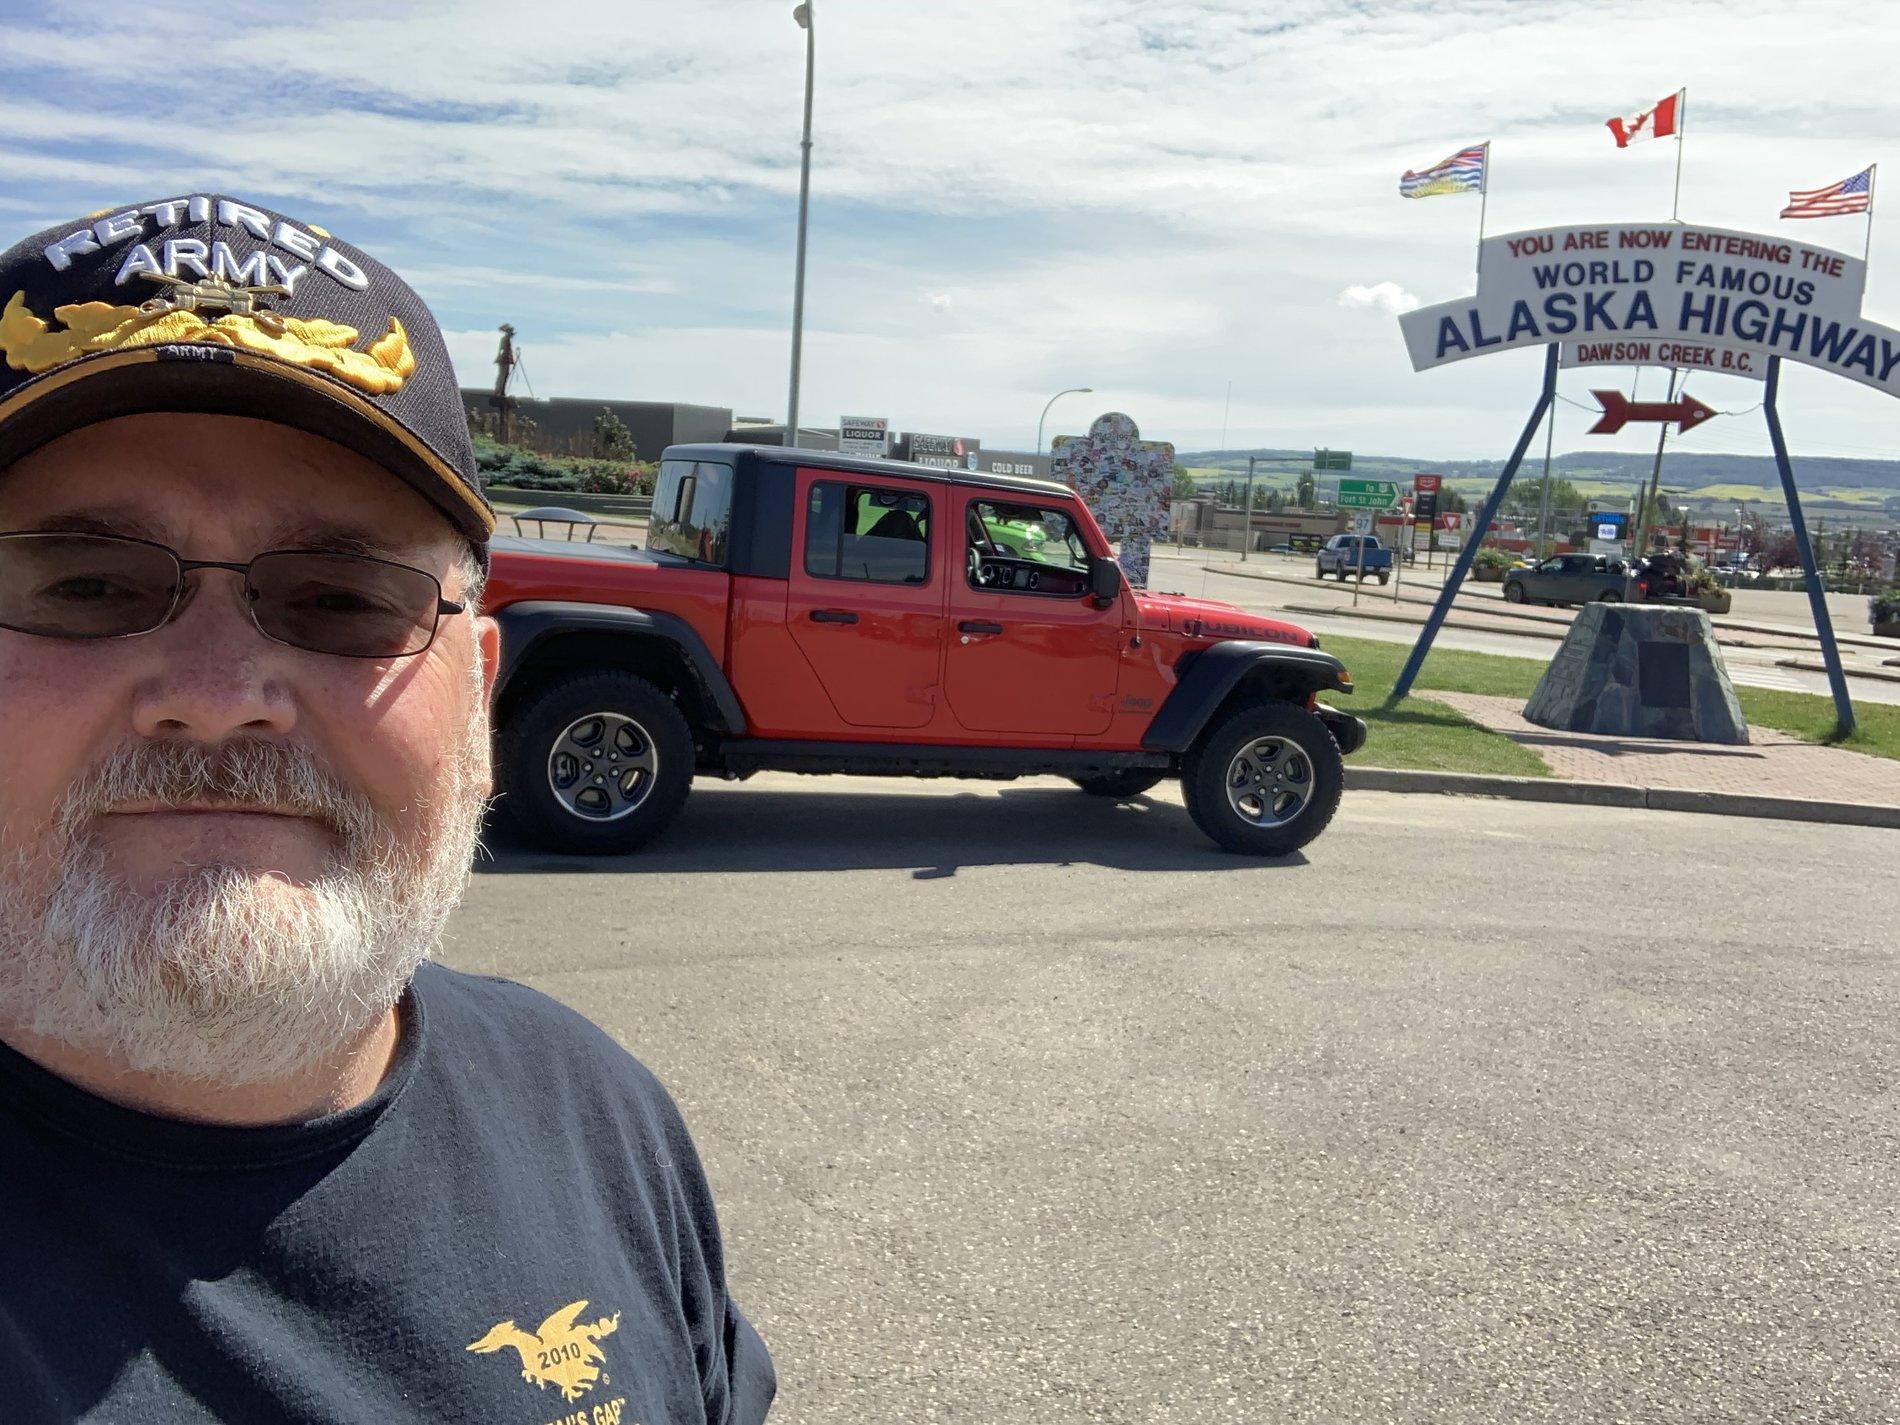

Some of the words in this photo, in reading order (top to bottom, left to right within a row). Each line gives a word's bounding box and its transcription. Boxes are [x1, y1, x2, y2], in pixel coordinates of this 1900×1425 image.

[44, 196, 369, 292] RETIRED
[1507, 233, 1554, 258] YOU
[1562, 230, 1609, 253] ARE
[1618, 229, 1673, 250] NOW
[1681, 231, 1792, 265] ENTERING
[1800, 249, 1845, 278] THE
[115, 238, 307, 298] ARMY
[1532, 258, 1655, 290] WORLD
[1676, 260, 1816, 306] FAMOUS
[1435, 289, 1659, 359] ALASKA
[1679, 291, 1900, 383] HIGHWAY
[167, 344, 217, 360] ARMY
[1577, 341, 1651, 364] DAWSON
[1658, 342, 1715, 366] CREEK
[1721, 350, 1754, 373] B.C.
[842, 418, 875, 427] SAFEWAY
[845, 430, 881, 439] LIQUOR
[991, 462, 1012, 474] COLD
[1014, 463, 1034, 475] BEER
[1365, 483, 1375, 493] To
[1340, 494, 1356, 504] Fort
[1368, 496, 1388, 506] John
[1356, 518, 1369, 529] 97
[537, 1342, 581, 1370] 2010
